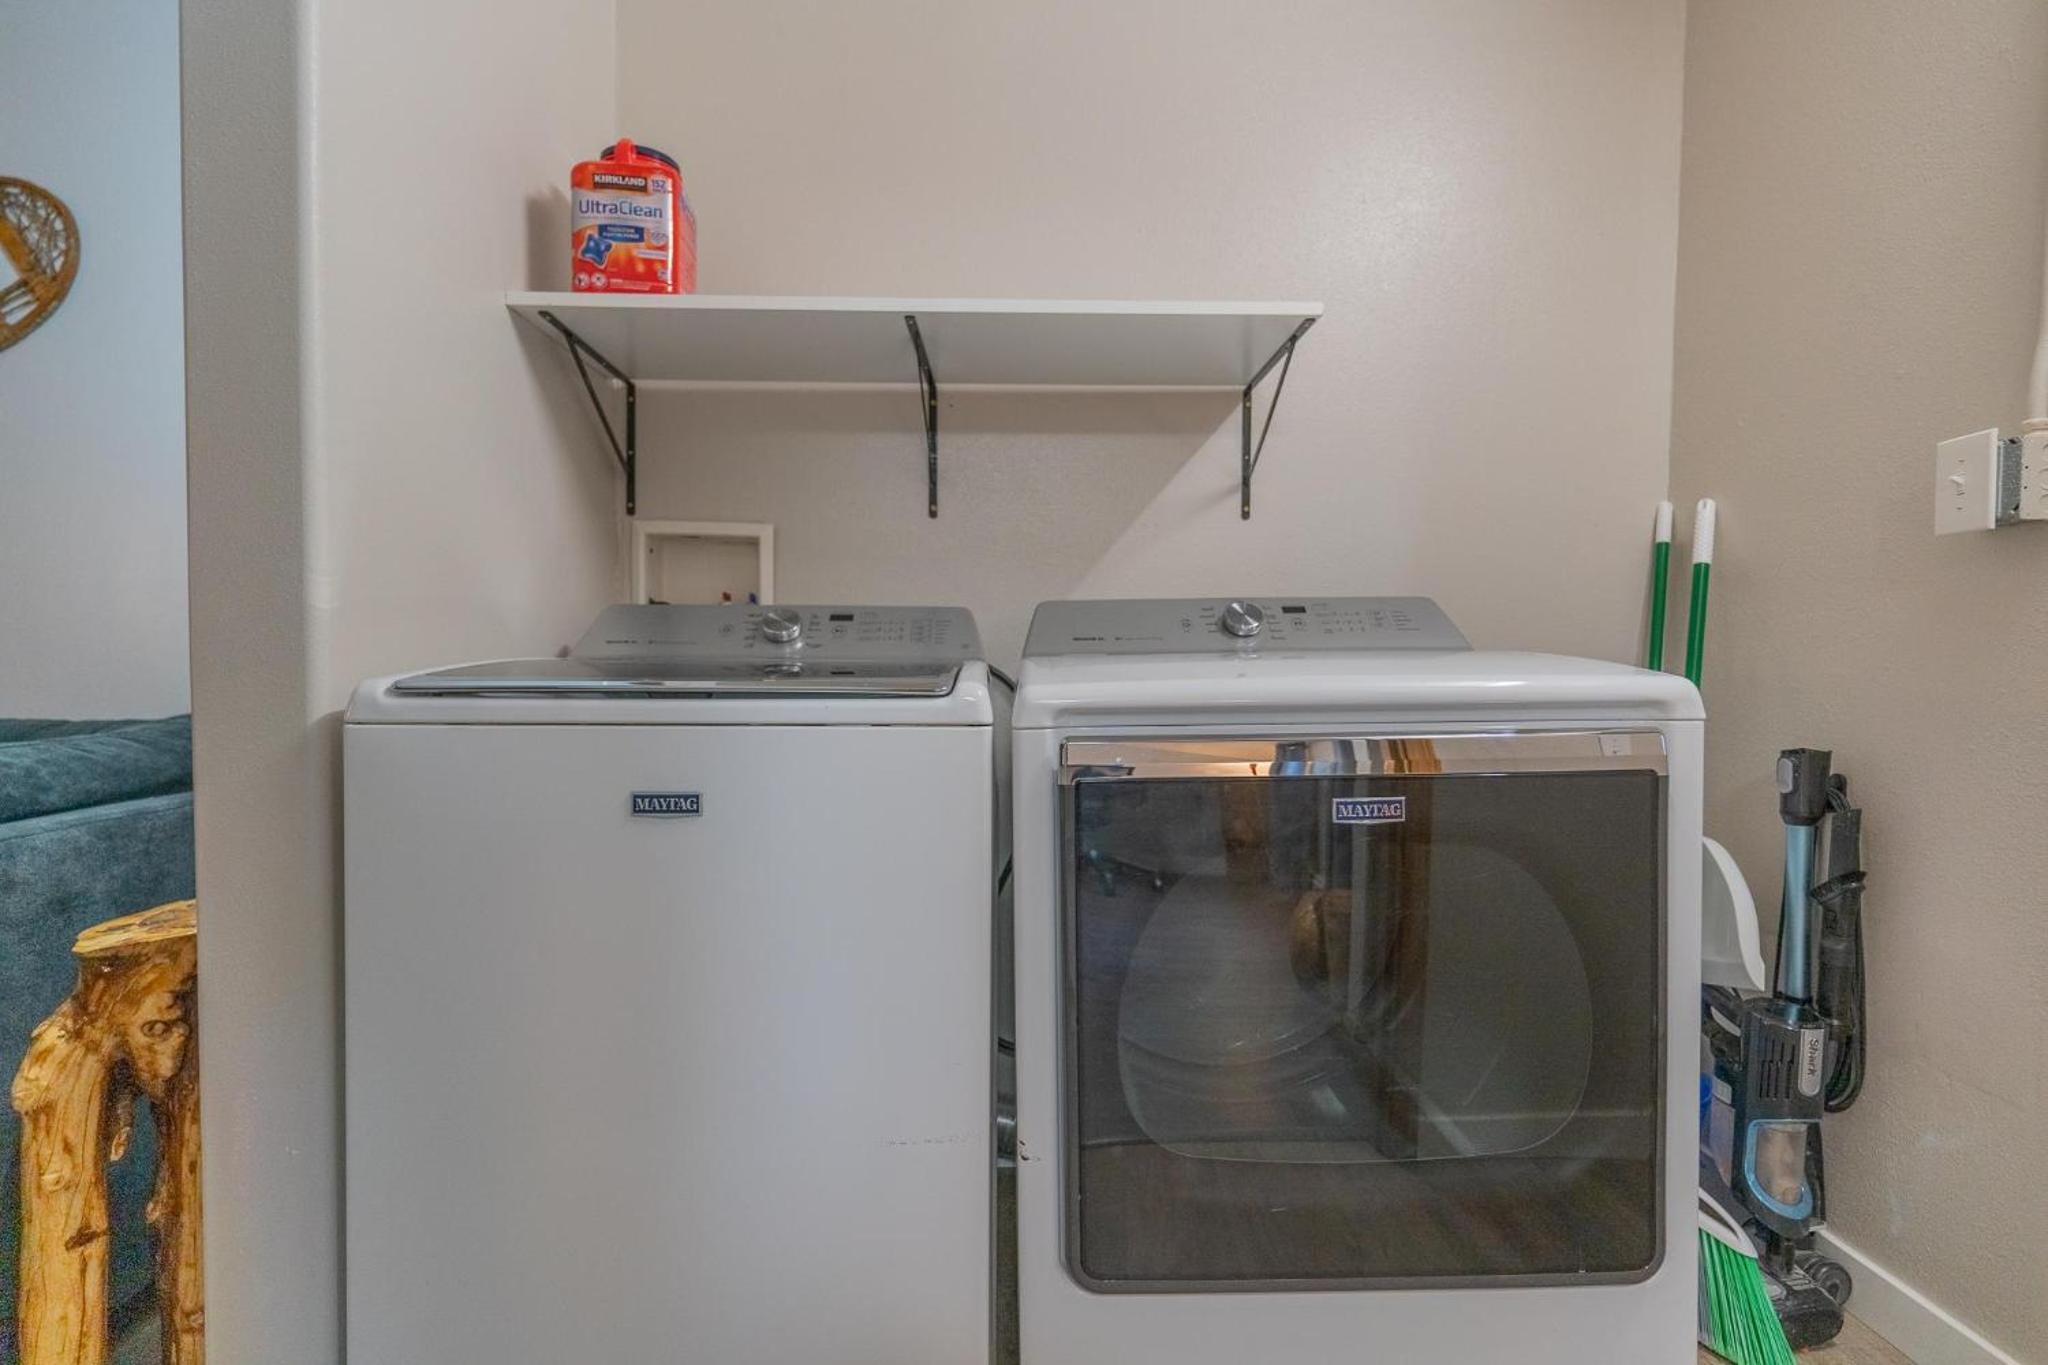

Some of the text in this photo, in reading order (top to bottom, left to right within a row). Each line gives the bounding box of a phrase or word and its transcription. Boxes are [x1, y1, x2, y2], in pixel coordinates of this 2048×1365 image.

[594, 174, 645, 187] KIRKLAND
[579, 200, 662, 218] UltraClean
[634, 797, 697, 811] MAYTAG
[1338, 803, 1401, 817] MAYTAG
[1806, 1038, 1820, 1078] Shark
